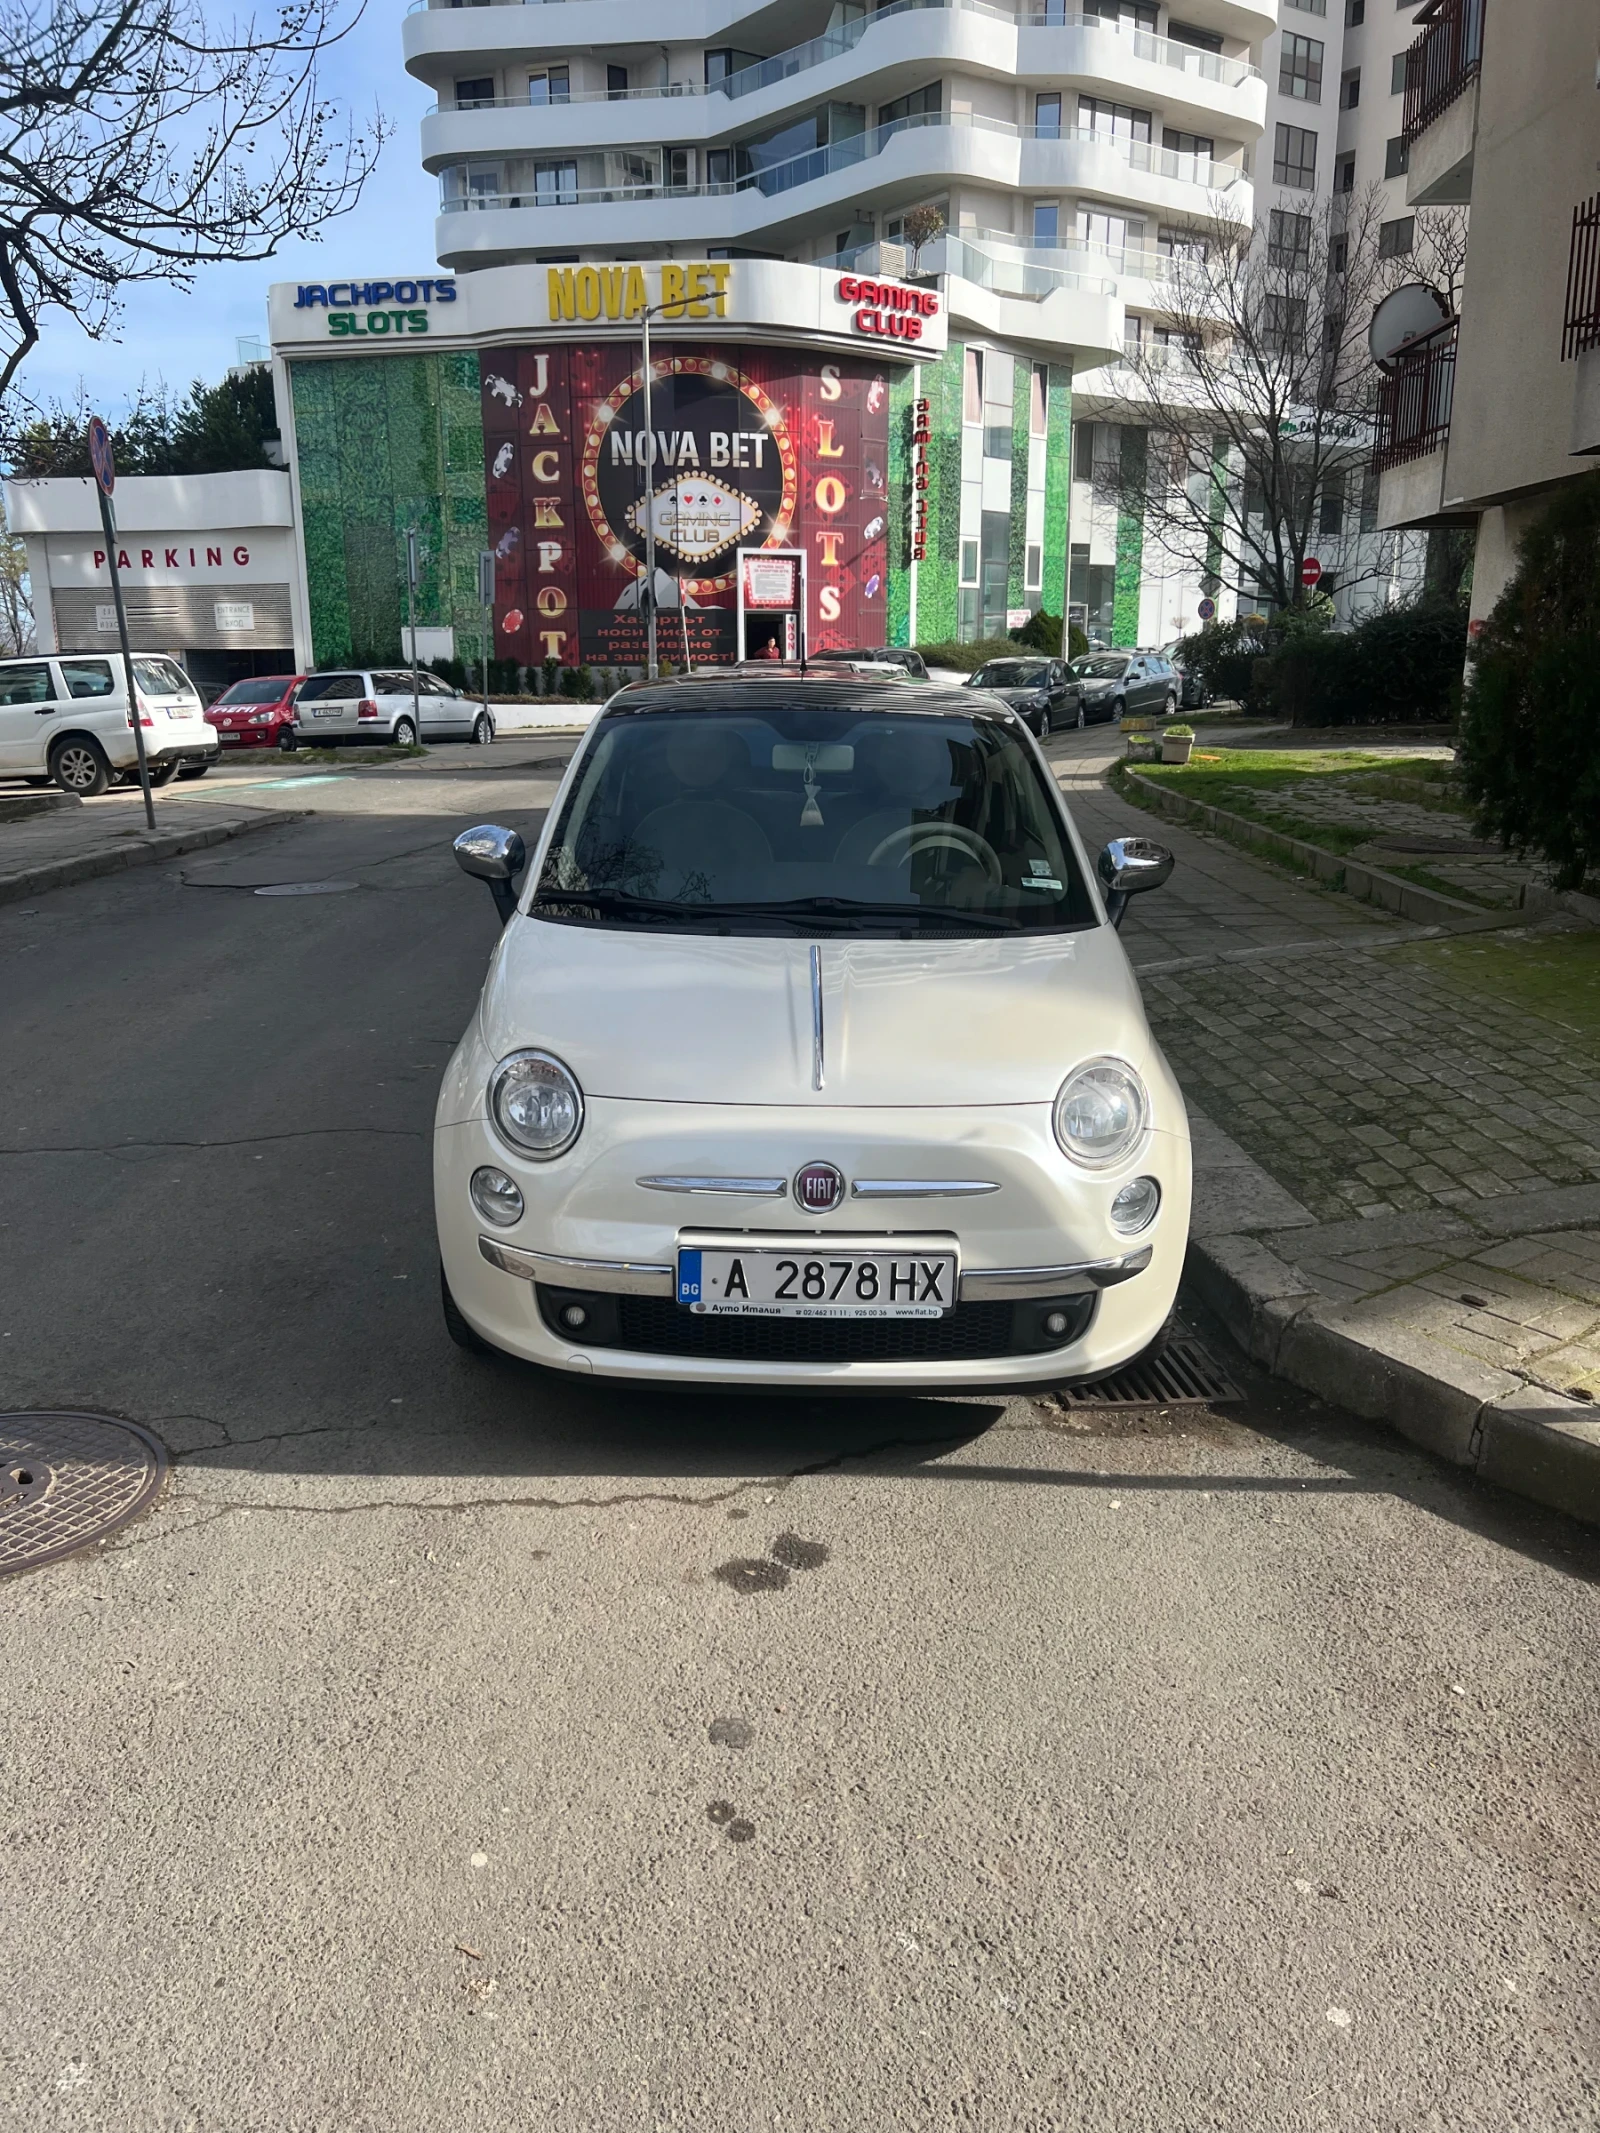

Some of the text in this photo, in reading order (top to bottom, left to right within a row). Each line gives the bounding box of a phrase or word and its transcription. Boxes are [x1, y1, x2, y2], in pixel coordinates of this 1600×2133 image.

[547, 263, 732, 321] NOVA BET
[839, 277, 939, 316] GAMING
[328, 310, 428, 336] SLOTS
[856, 308, 923, 339] CLUB
[611, 431, 768, 468] NOVA BET
[815, 364, 846, 622] SLOTS
[529, 353, 568, 661] JACKPOT
[659, 511, 730, 527] GAMING
[670, 529, 720, 543] CLUB
[94, 546, 250, 569] PARKING
[217, 606, 251, 614] ENTRANCE
[597, 628, 644, 637] носи
[701, 628, 723, 637] от
[585, 653, 608, 662] на
[806, 1177, 834, 1199] FIAT
[681, 1283, 699, 1295] BG
[774, 1260, 880, 1301] 2878
[712, 1305, 739, 1315] Ауто
[896, 1308, 938, 1317] www.fiat.bg
